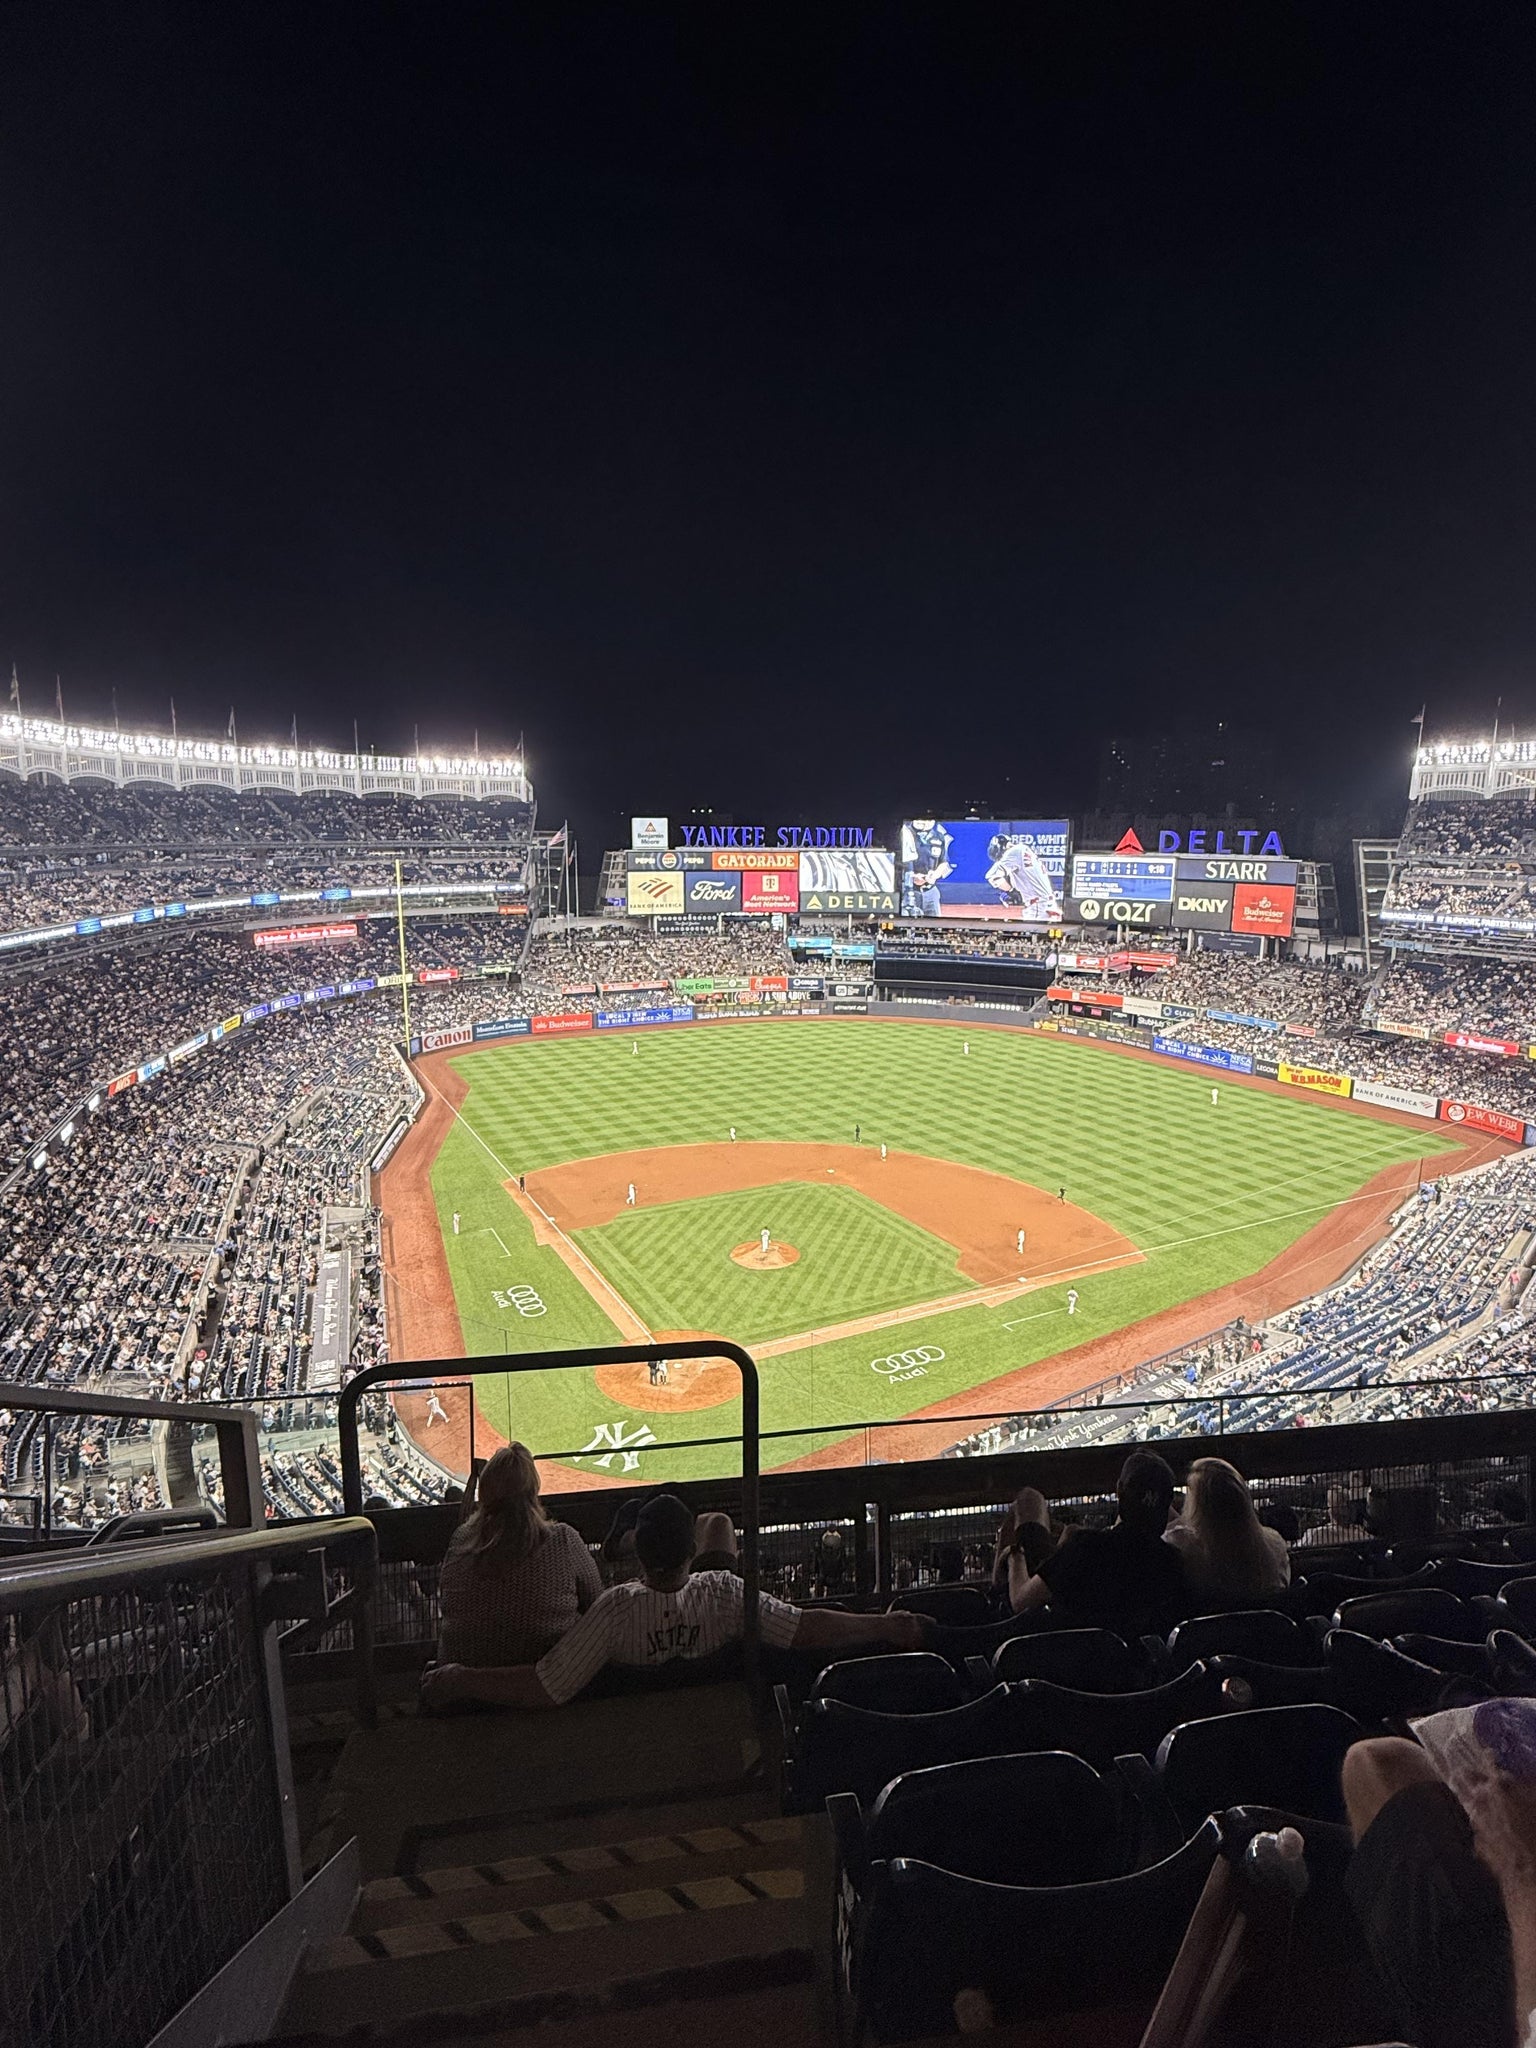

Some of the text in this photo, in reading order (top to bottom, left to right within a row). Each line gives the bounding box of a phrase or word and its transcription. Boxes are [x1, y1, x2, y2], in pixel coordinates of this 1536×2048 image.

[680, 825, 874, 849] YANKEE STADIUM
[1011, 834, 1036, 846] RED,
[1158, 830, 1284, 856] DELTA
[635, 857, 656, 865] PEPSI
[683, 857, 705, 865] PEPSI
[717, 855, 795, 868] GATORADE
[1205, 861, 1268, 881] STARR
[690, 880, 737, 901] Ford
[750, 894, 791, 902] America's
[828, 895, 894, 909] DELTA
[1177, 896, 1229, 914] DKNY
[1103, 901, 1157, 923] razr
[1243, 906, 1285, 918] Budweiser
[695, 982, 712, 990] Eats
[771, 991, 787, 1001] SUB
[787, 991, 811, 1001] ABOVE
[548, 1019, 590, 1029] Budweiser
[1379, 1022, 1396, 1031] Parts
[423, 1029, 471, 1050] Canon
[1161, 1039, 1181, 1049] LOCAL
[1155, 1043, 1166, 1051] THE
[1167, 1046, 1186, 1055] RIGHT
[1186, 1051, 1210, 1061] CHOICE
[1355, 1087, 1373, 1097] BANK
[1386, 1094, 1418, 1107] AMERICA
[1466, 1108, 1486, 1119] F.W.
[1488, 1114, 1518, 1132] WEBB
[490, 1290, 512, 1309] Audi
[888, 1366, 929, 1385] Audi
[1048, 1429, 1080, 1449] York
[1073, 1413, 1118, 1439] Yankees
[572, 1419, 658, 1473] NY
[646, 1623, 701, 1657] JETER
